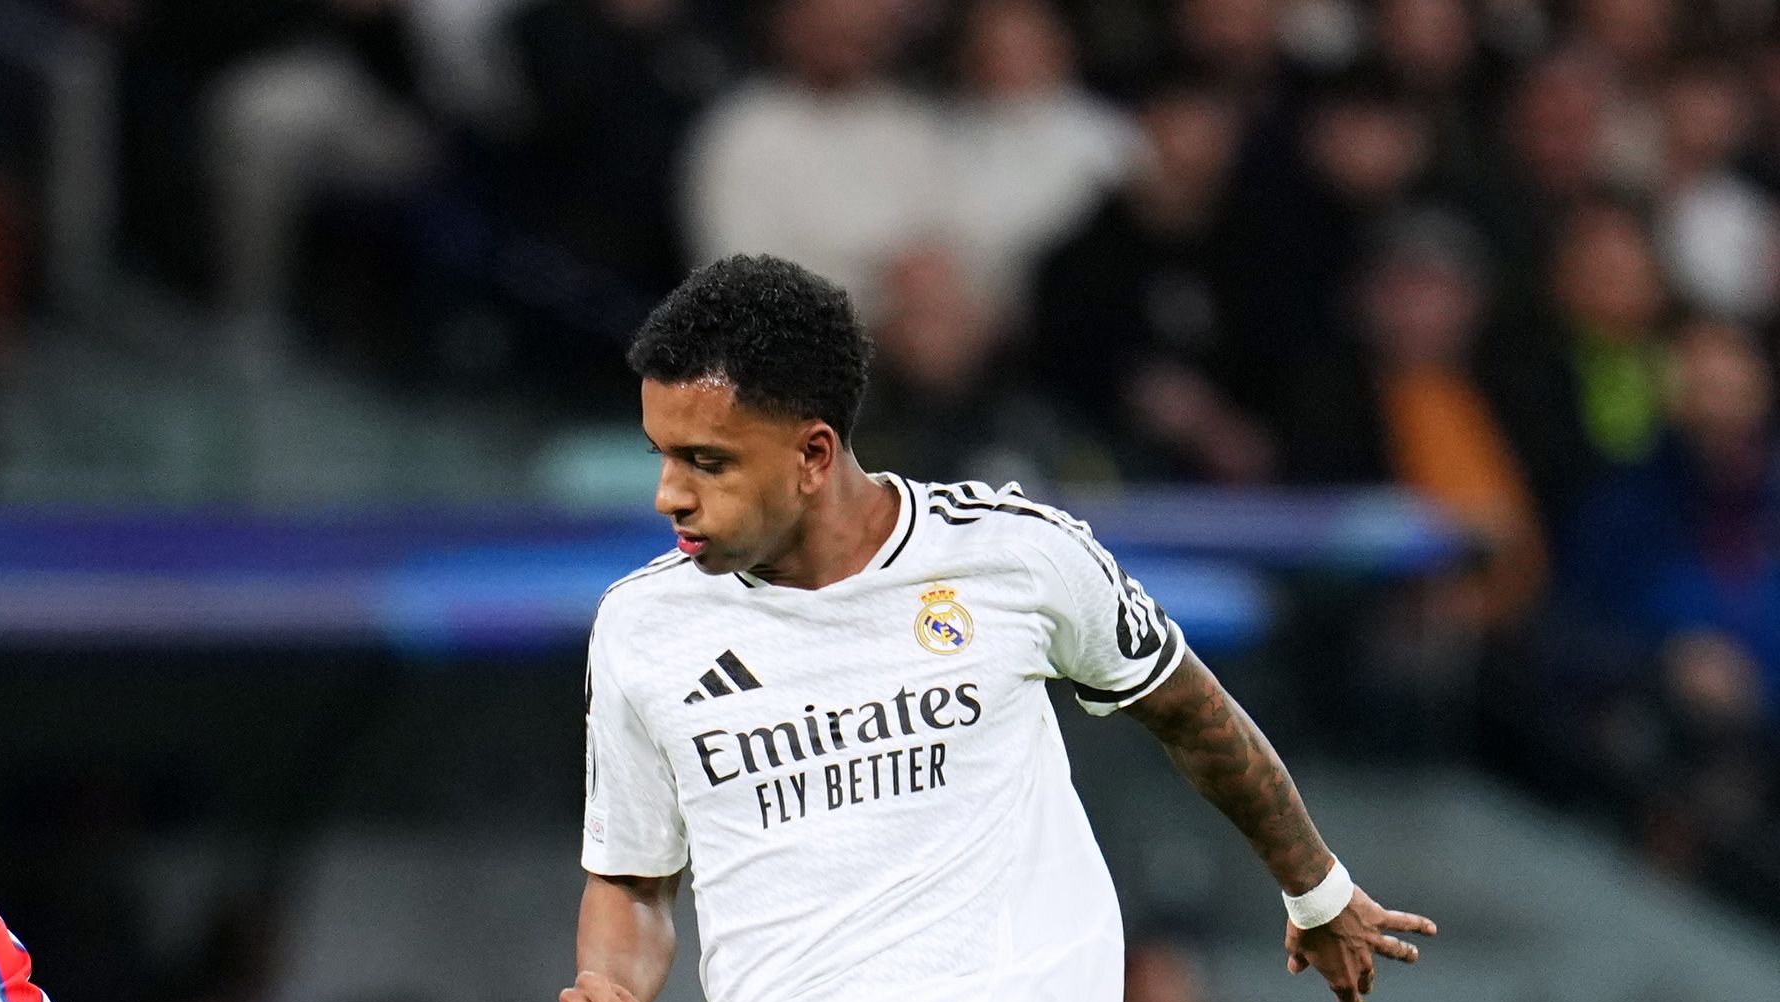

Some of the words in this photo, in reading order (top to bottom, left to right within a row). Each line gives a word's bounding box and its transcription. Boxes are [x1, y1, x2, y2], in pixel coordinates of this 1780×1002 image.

[692, 683, 982, 788] Emirates
[755, 771, 806, 830] FLY
[824, 742, 947, 811] BETTER
